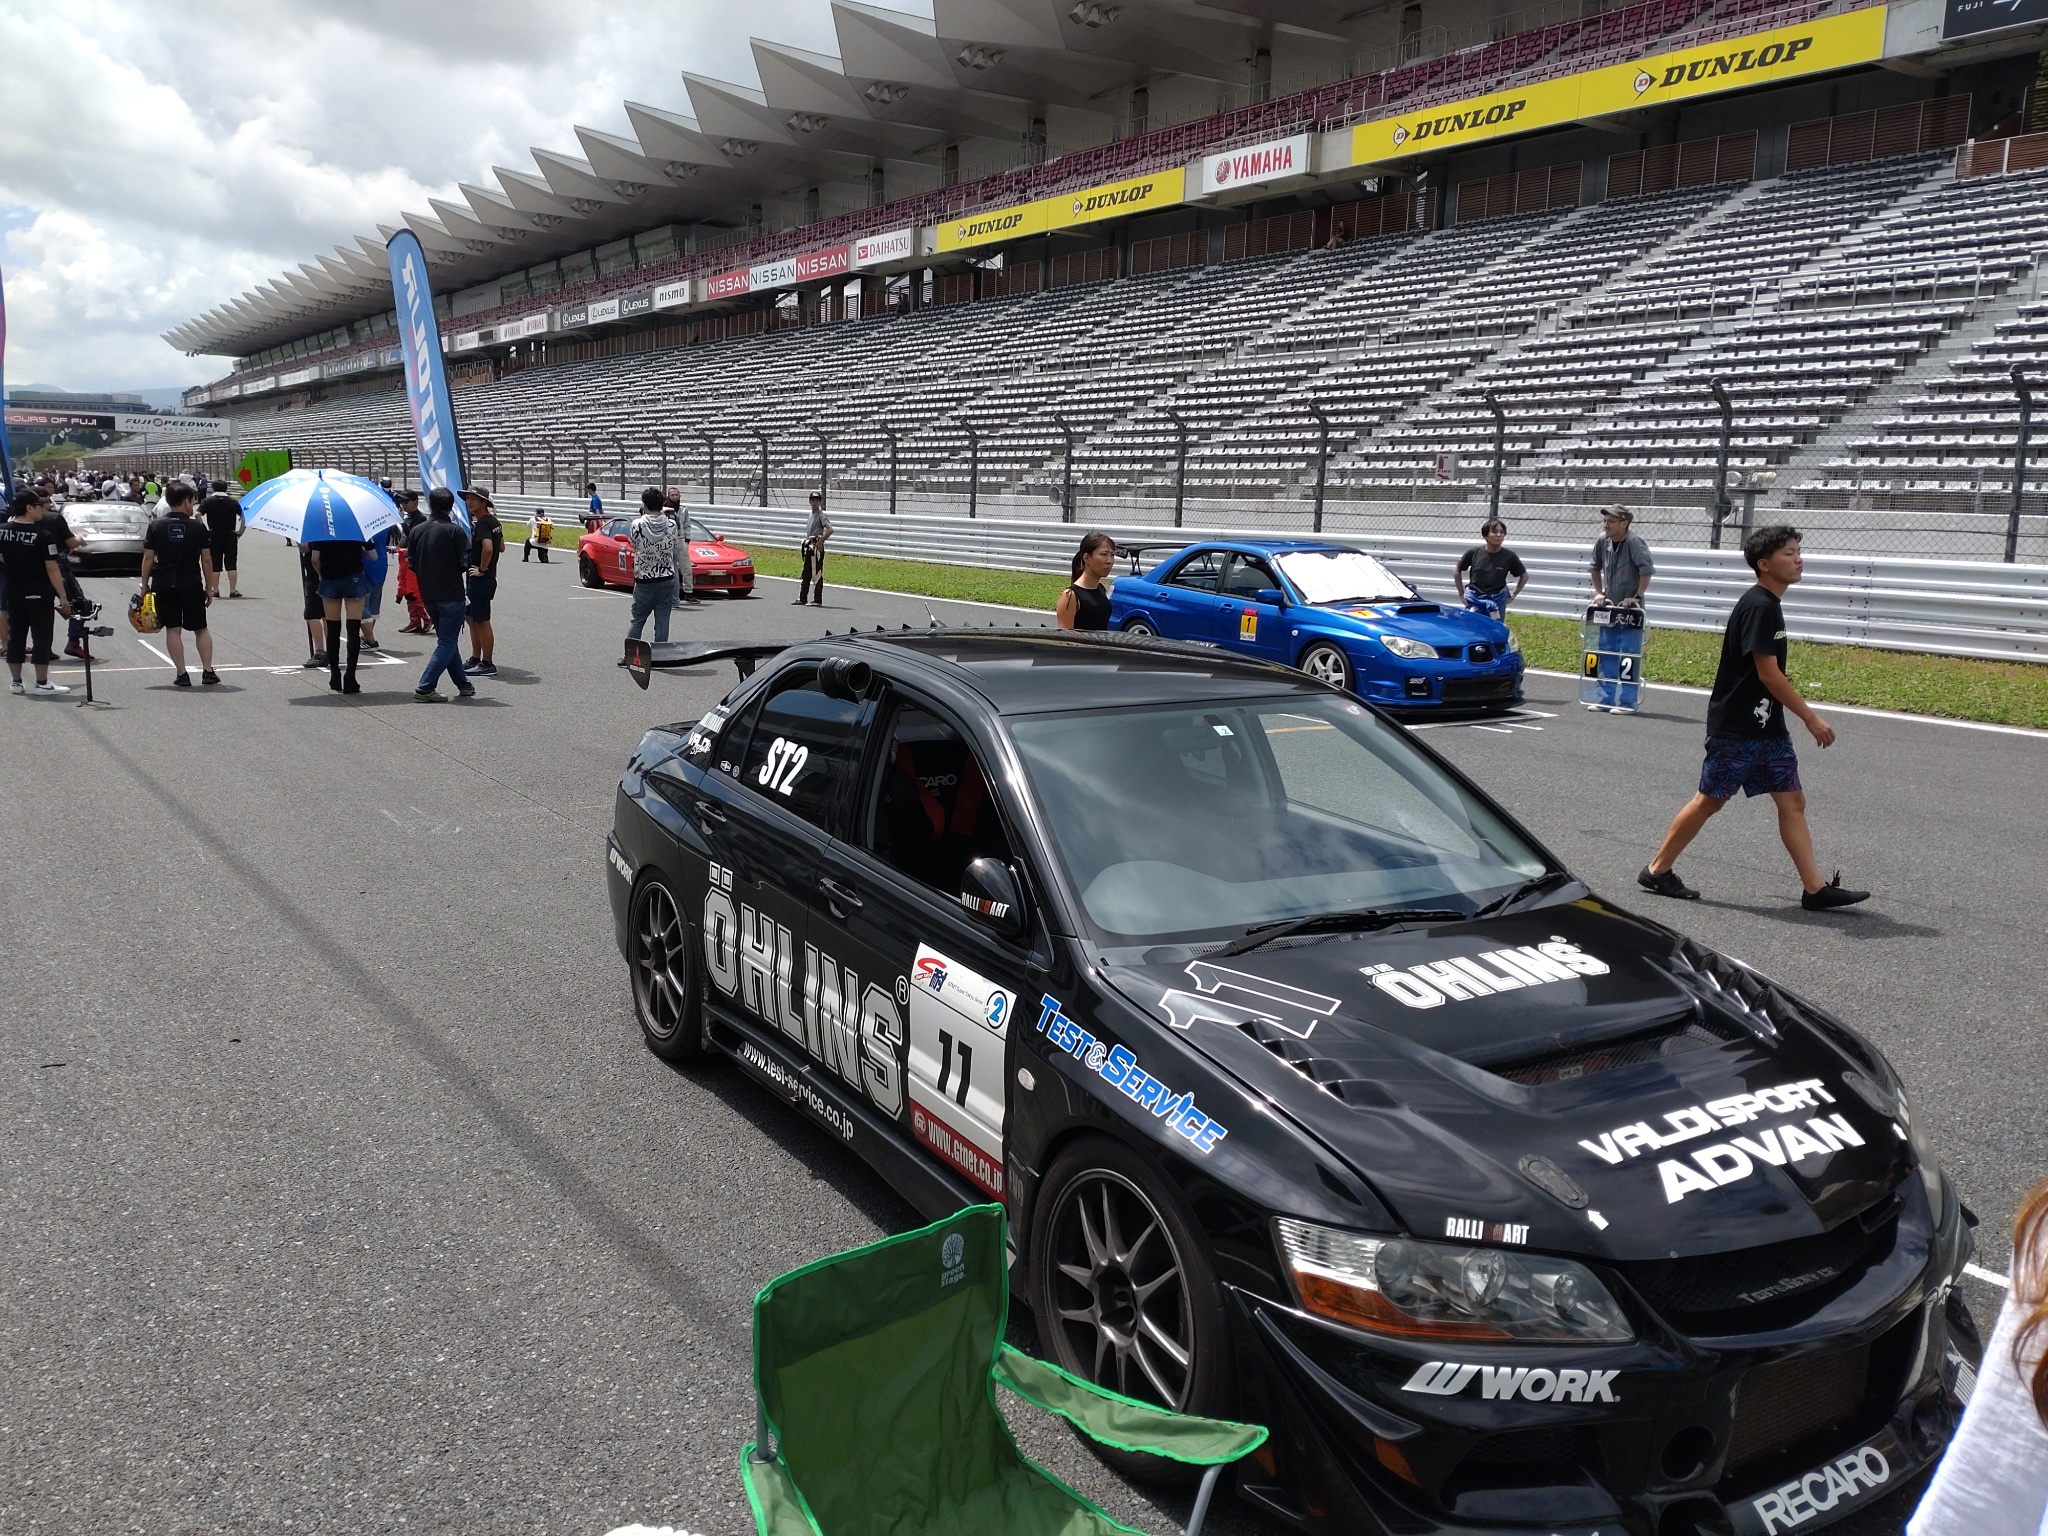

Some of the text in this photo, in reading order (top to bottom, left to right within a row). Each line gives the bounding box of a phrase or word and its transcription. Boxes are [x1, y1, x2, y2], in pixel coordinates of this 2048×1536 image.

[1957, 1, 1983, 13] FUJI
[1658, 37, 1814, 88] DUNLOP
[1411, 99, 1527, 141] DUNLOP
[1231, 145, 1293, 181] YAMAHA
[1084, 183, 1153, 212] DUNLOP
[967, 213, 1023, 238] DUNLOP
[869, 236, 910, 258] DAIHATSU
[750, 264, 796, 286] NISSAN
[797, 251, 848, 276] NISSAN
[708, 273, 749, 295] NISSAN
[597, 306, 616, 316] LEXUS
[628, 298, 649, 310] LEXUS
[568, 312, 586, 323] LEXUS
[5, 415, 47, 424] HOURS
[71, 418, 97, 426] FUJI
[260, 517, 299, 531] TEMPESTA
[266, 523, 287, 532] ENZO
[1585, 653, 1633, 680] P 2
[758, 737, 809, 797] ST2
[616, 851, 634, 886] WORK
[988, 996, 1005, 1023] 2
[1657, 1113, 1866, 1204] ADVAN
[941, 1263, 965, 1282] green
[1480, 1365, 1617, 1403] WORK
[1752, 1445, 1891, 1536] RECARO
